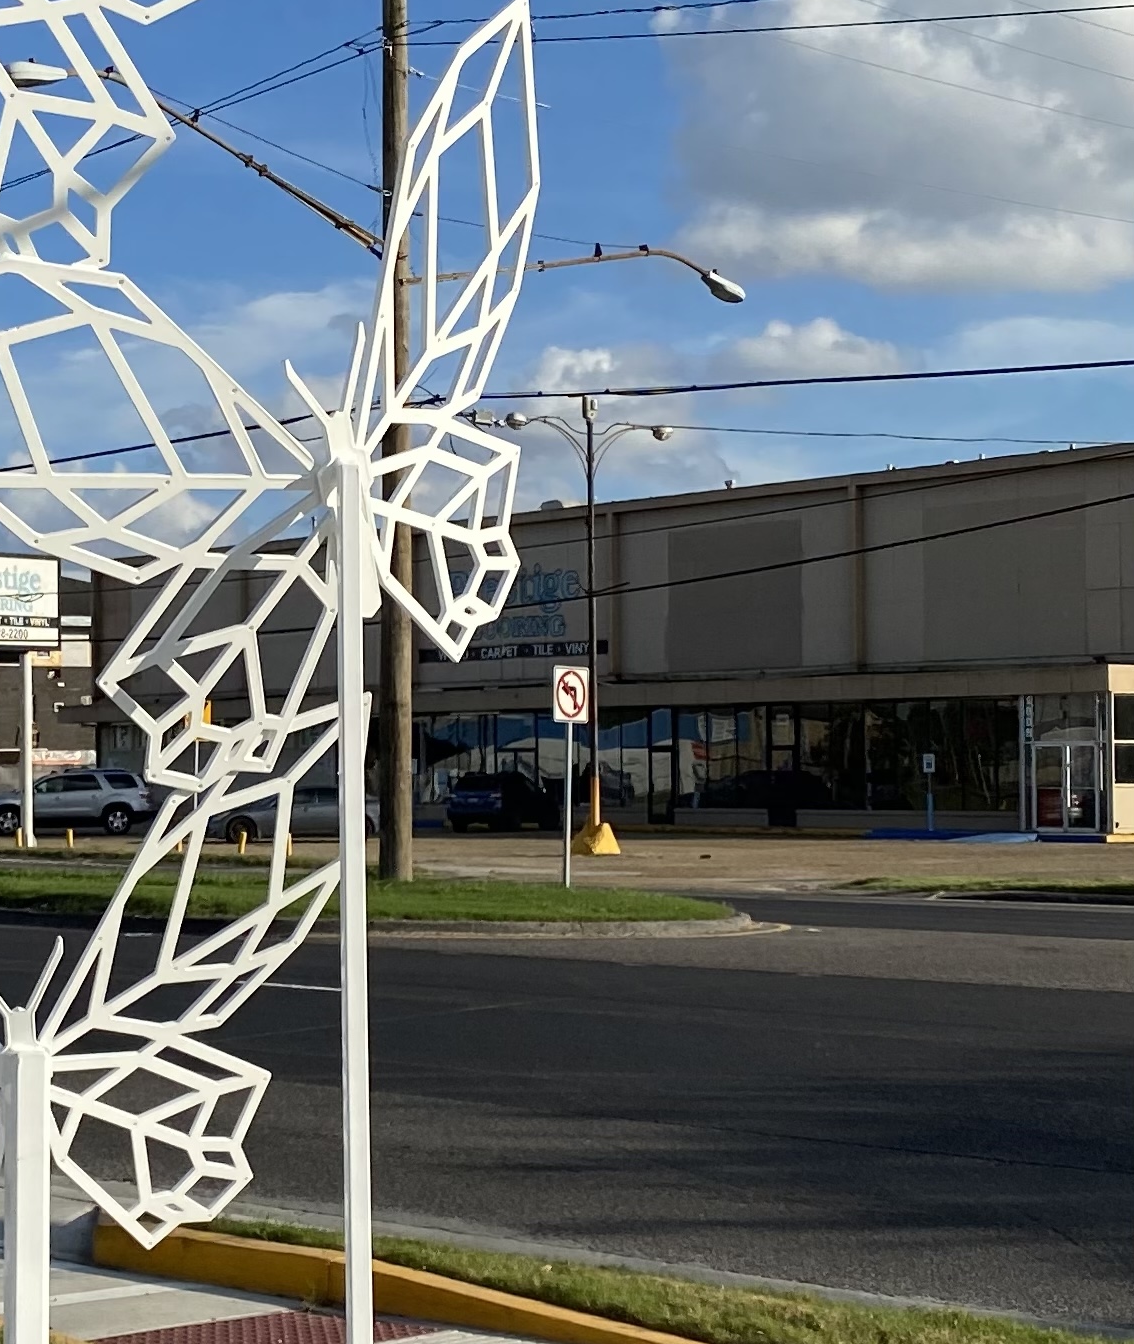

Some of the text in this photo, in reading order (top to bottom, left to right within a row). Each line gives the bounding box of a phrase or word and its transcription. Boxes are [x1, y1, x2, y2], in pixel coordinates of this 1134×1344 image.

[9, 616, 24, 626] TILE
[29, 617, 50, 627] VINYL
[533, 643, 554, 656] TILE
[565, 642, 590, 655] VINY
